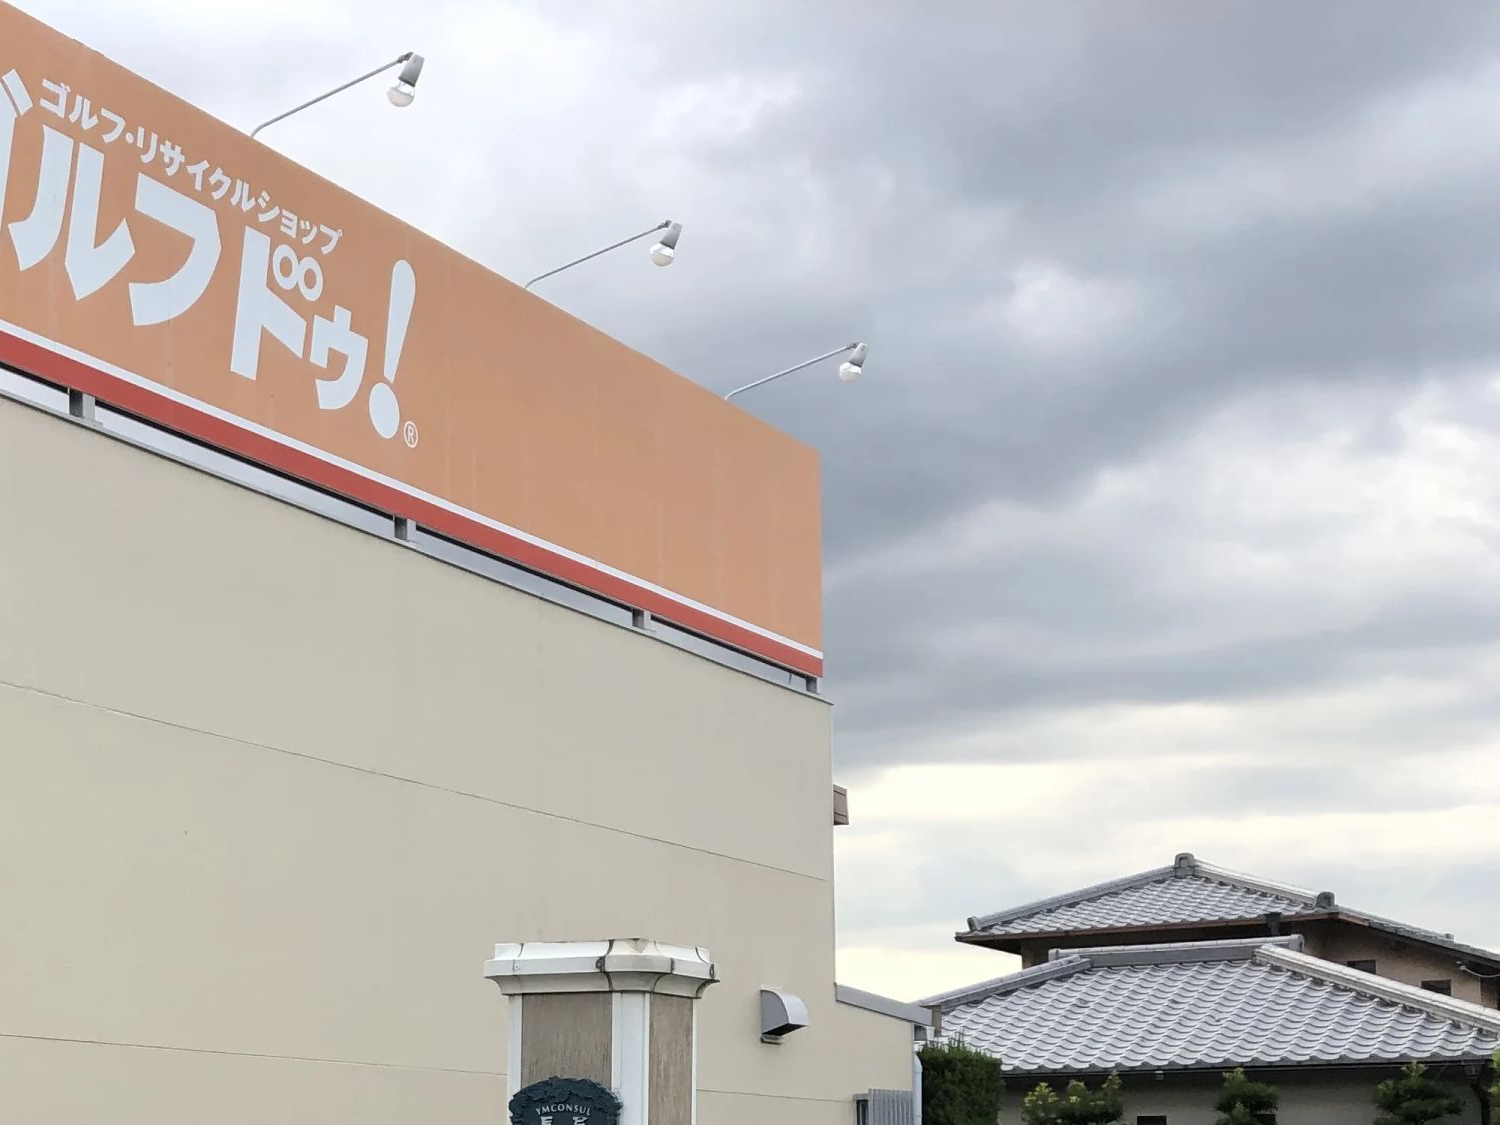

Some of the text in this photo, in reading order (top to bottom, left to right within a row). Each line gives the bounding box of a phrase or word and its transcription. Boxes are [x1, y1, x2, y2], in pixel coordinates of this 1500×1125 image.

[39, 77, 343, 254] ゴルフ・リサイクルショップ
[535, 1103, 591, 1116] YMCONSUL
